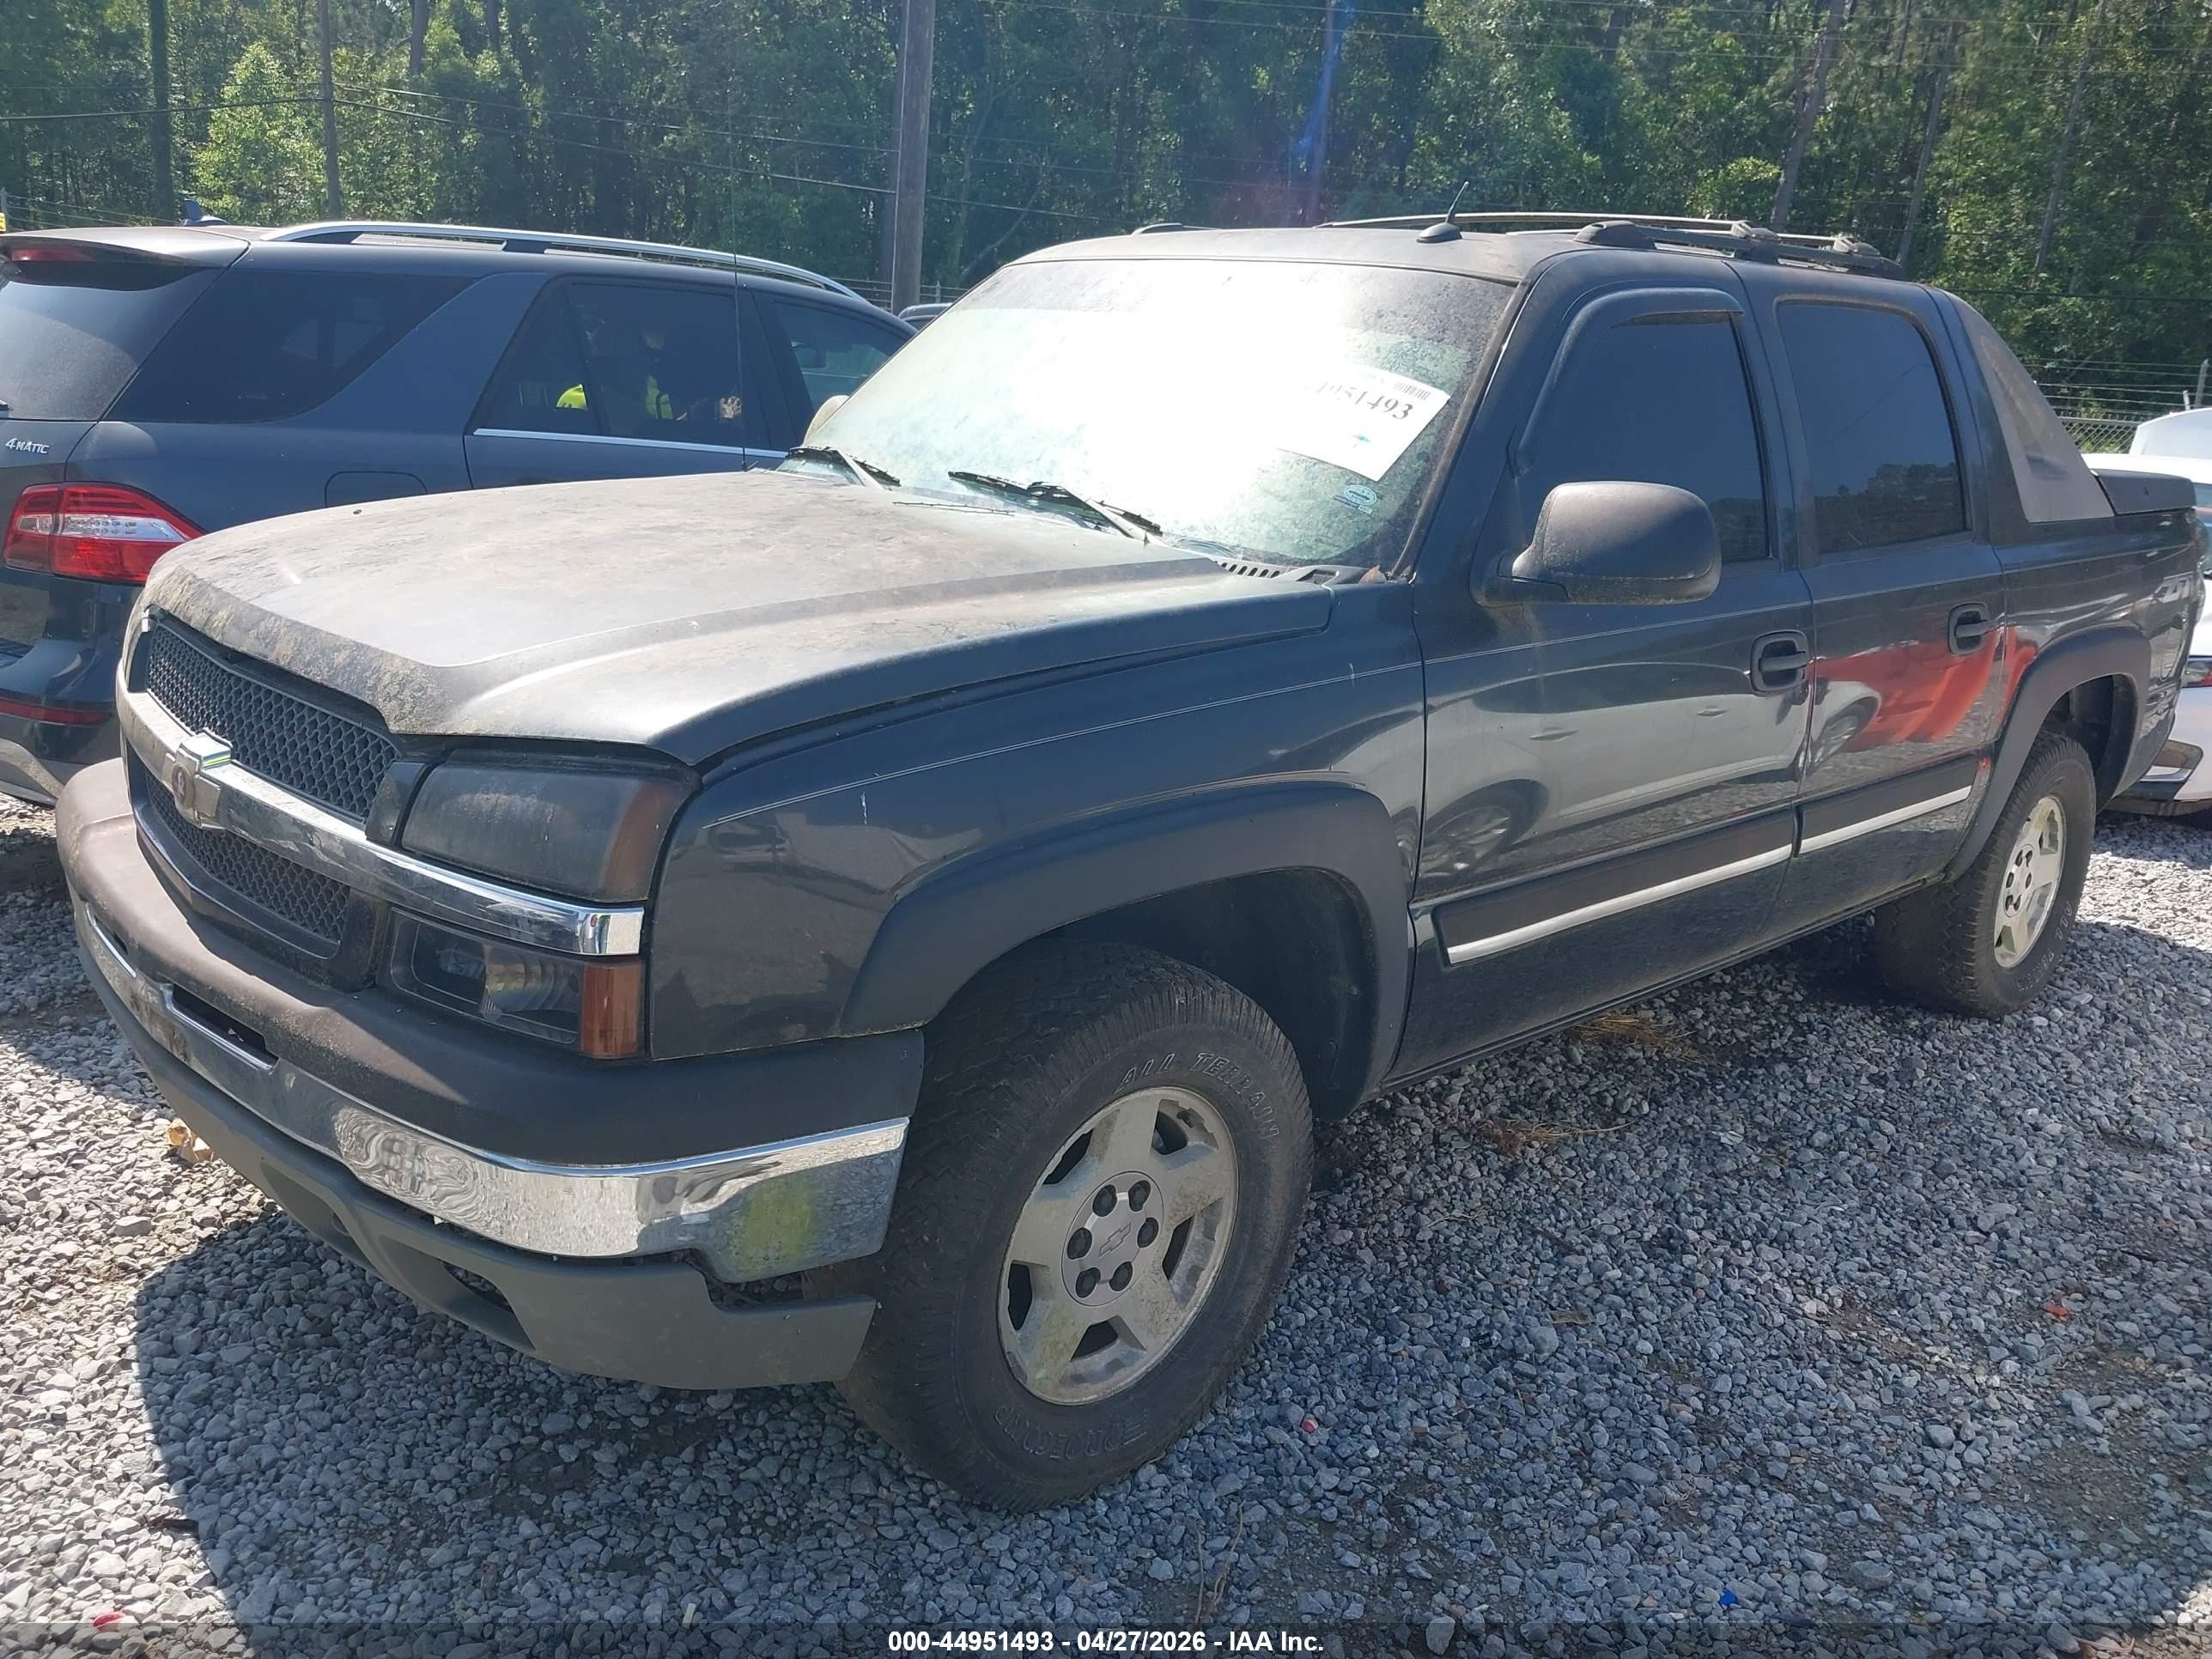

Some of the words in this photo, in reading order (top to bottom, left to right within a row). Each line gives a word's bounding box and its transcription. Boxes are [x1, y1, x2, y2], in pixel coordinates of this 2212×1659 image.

[5, 438, 50, 453] 4MATIC
[1114, 1053, 1176, 1094] ALL
[1189, 1052, 1280, 1139] TERRAIN
